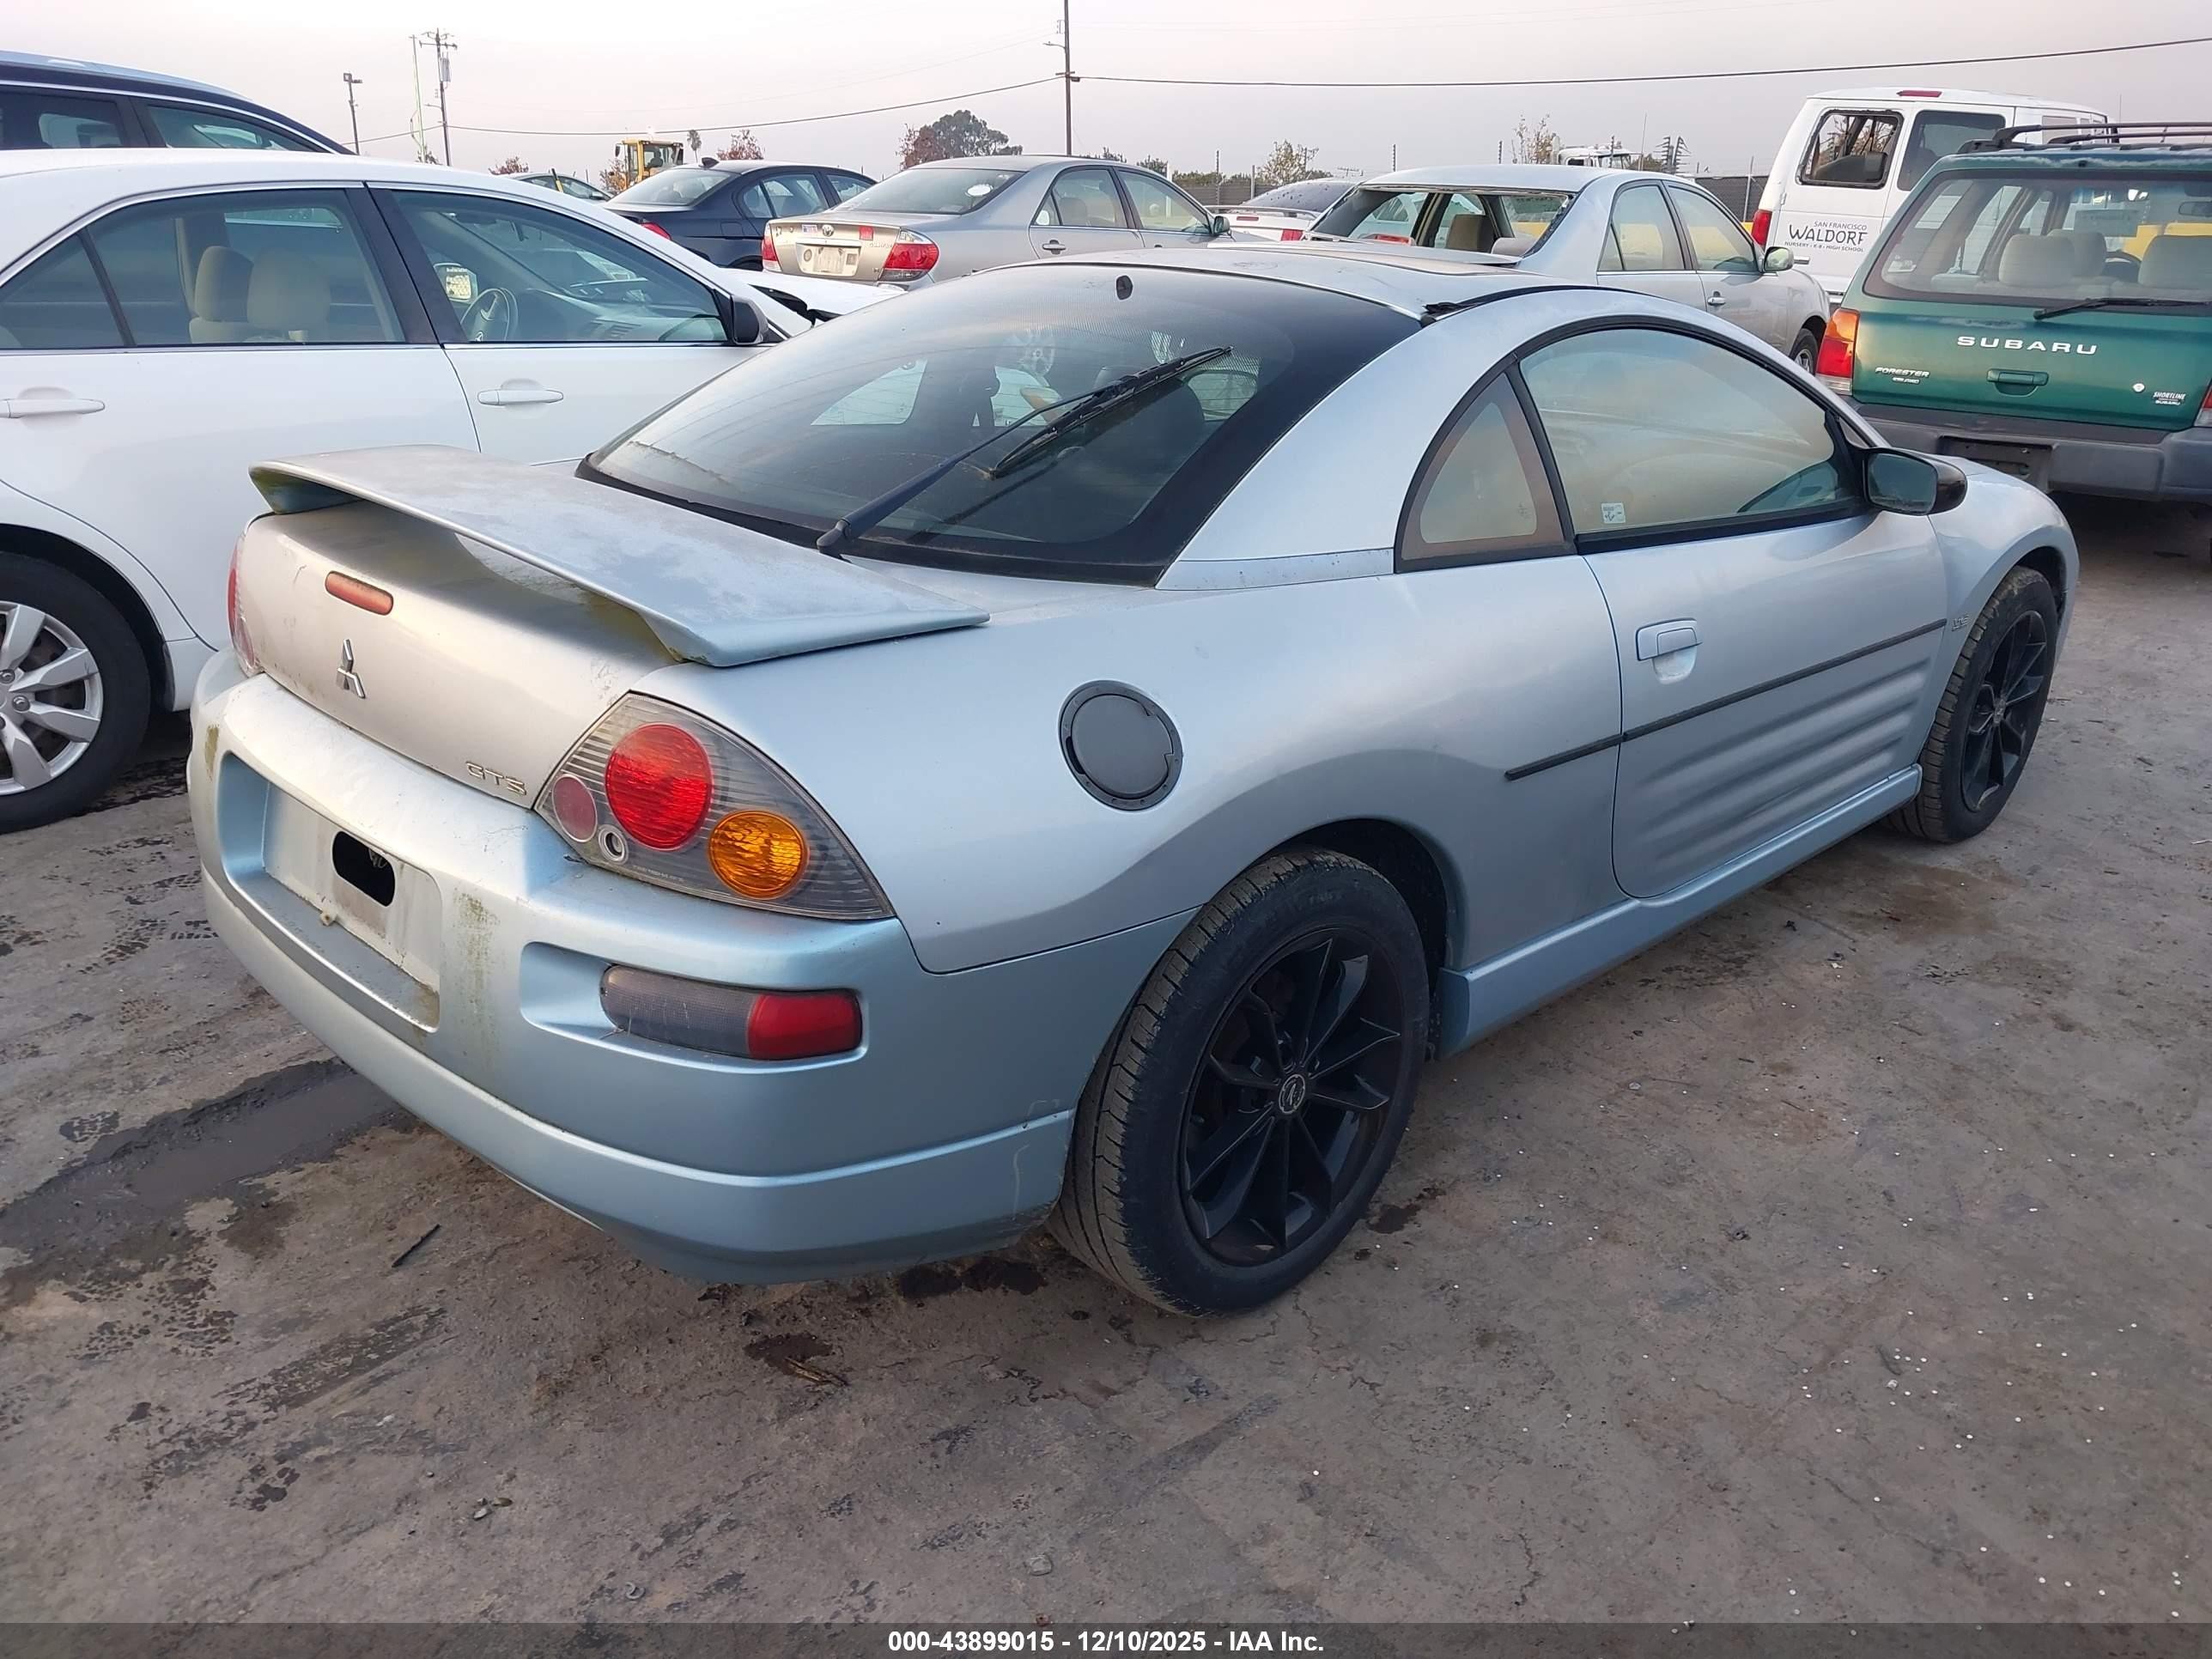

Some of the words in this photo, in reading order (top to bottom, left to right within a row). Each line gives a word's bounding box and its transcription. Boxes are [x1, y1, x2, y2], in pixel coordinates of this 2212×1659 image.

[1829, 222, 1868, 231] FRANCISCO
[1789, 224, 1869, 246] WALDORF
[1957, 336, 2097, 355] SUBARU
[1875, 367, 1930, 378] FORESTER
[2153, 391, 2186, 400] SHORTLINE
[465, 761, 526, 795] GTS
